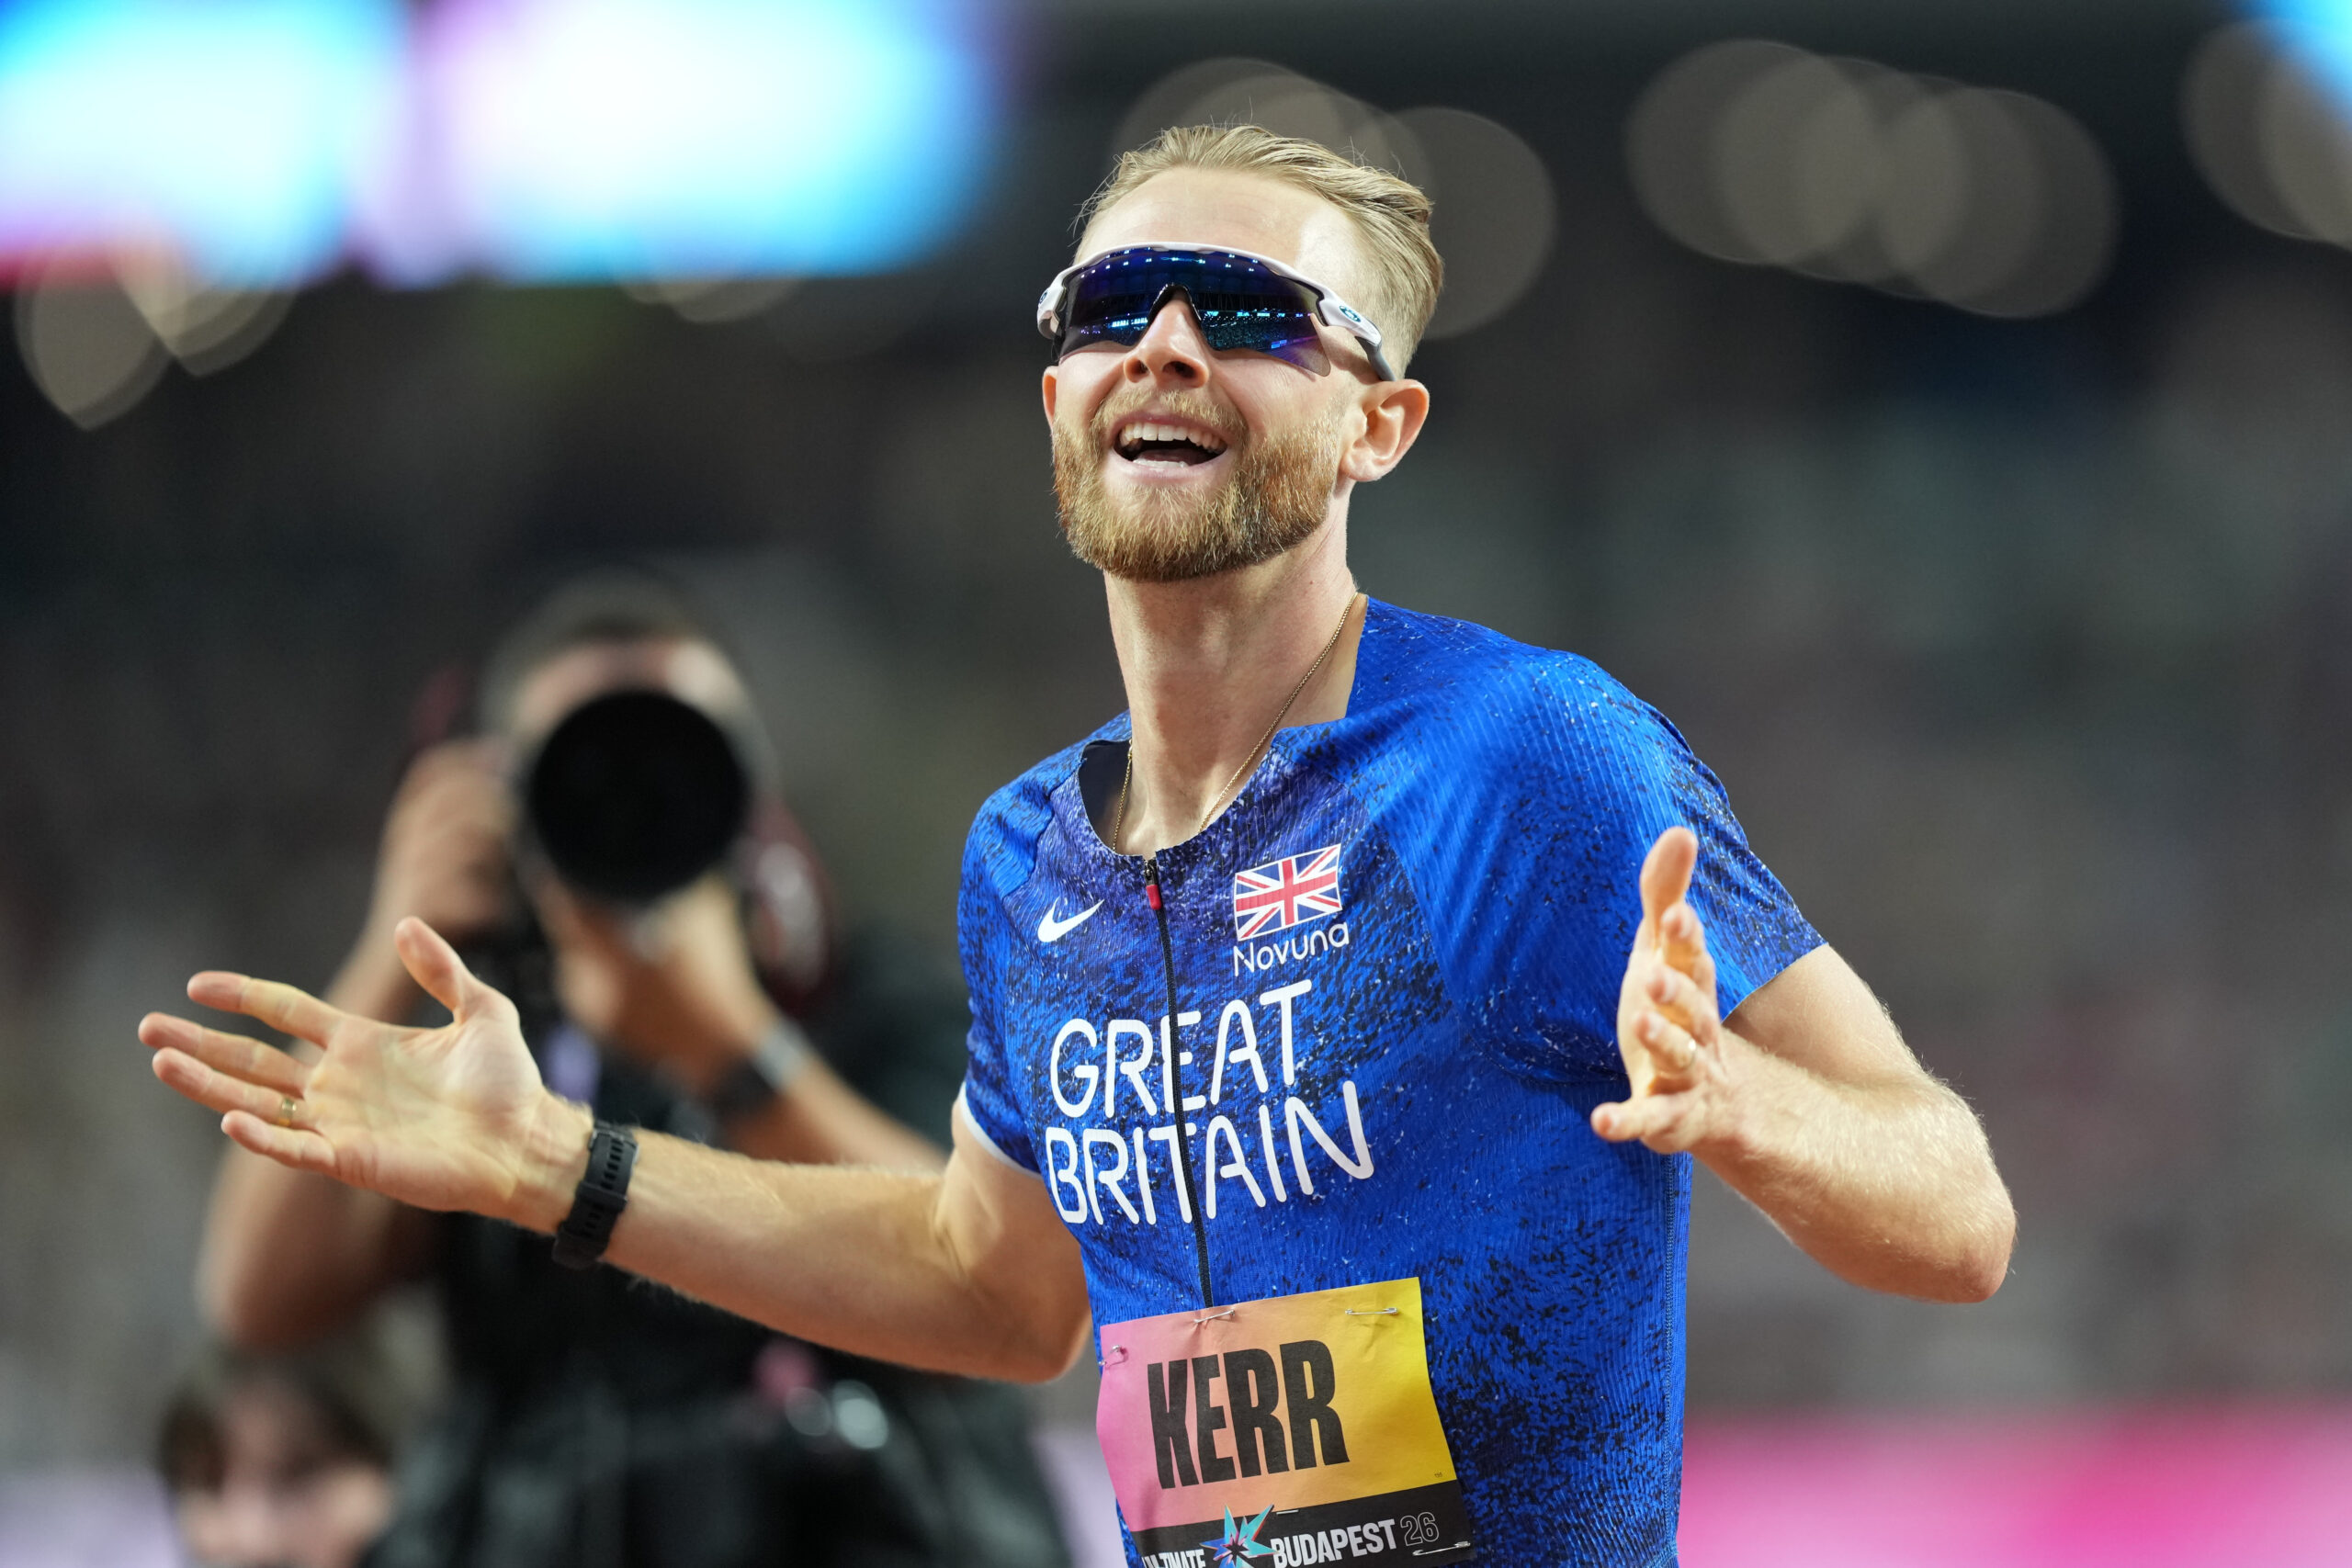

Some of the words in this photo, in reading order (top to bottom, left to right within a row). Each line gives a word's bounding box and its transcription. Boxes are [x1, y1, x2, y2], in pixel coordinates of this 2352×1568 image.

[1234, 922, 1350, 976] Novuna
[1049, 978, 1313, 1118] GREAT
[1046, 1080, 1375, 1225] BRITAIN
[1147, 1339, 1351, 1490] KERR
[1270, 1518, 1397, 1568] BUDAPEST
[1399, 1511, 1440, 1547] 26
